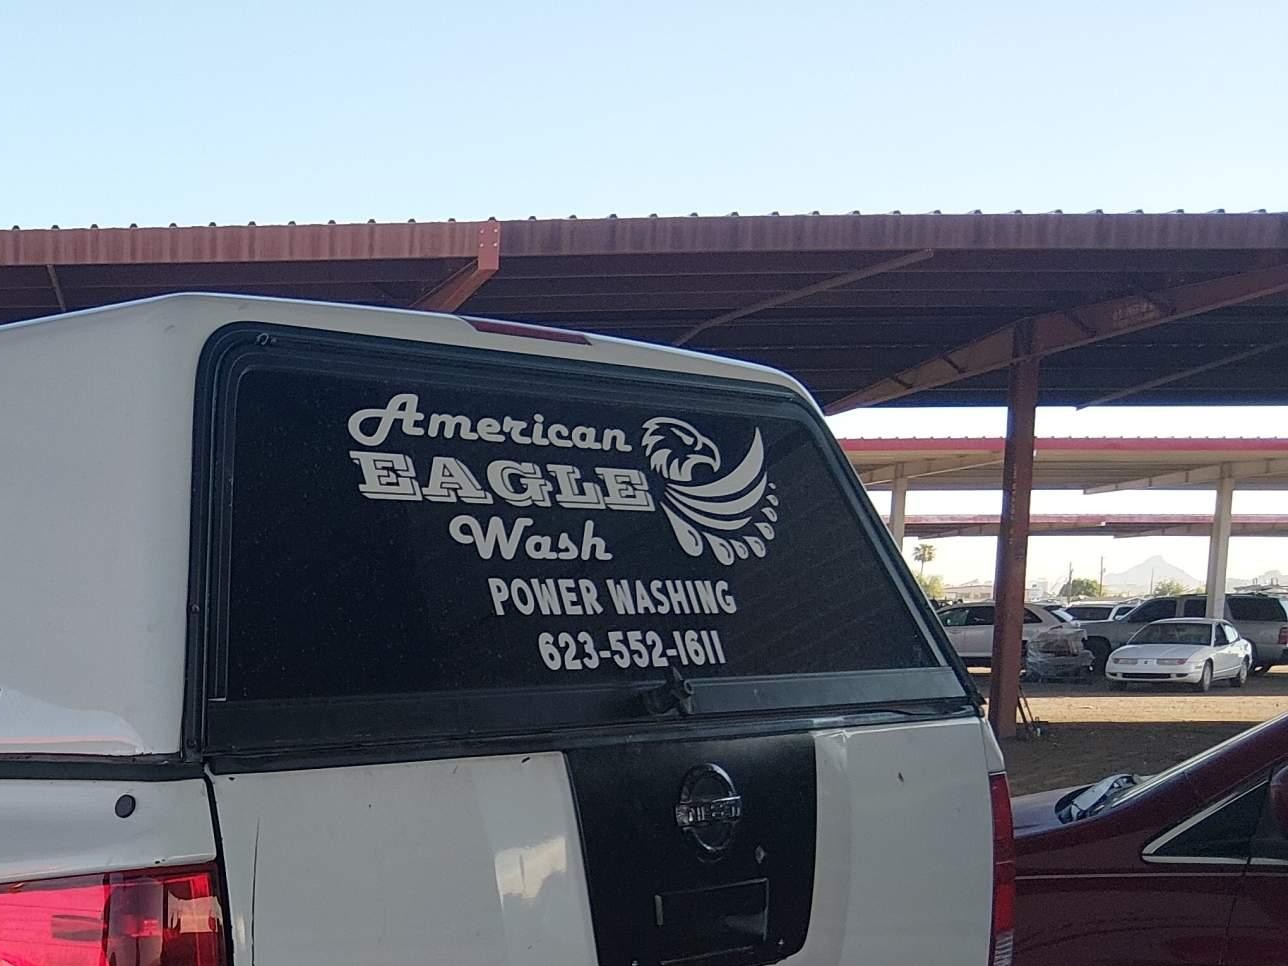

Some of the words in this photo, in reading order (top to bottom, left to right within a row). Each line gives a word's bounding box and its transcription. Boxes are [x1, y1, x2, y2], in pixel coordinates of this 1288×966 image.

[347, 393, 632, 453] American
[348, 450, 656, 512] EAGLE
[448, 514, 613, 561] Wash
[487, 577, 604, 616] POWER
[605, 579, 737, 615] WASHING
[538, 631, 726, 671] 623-552-1611
